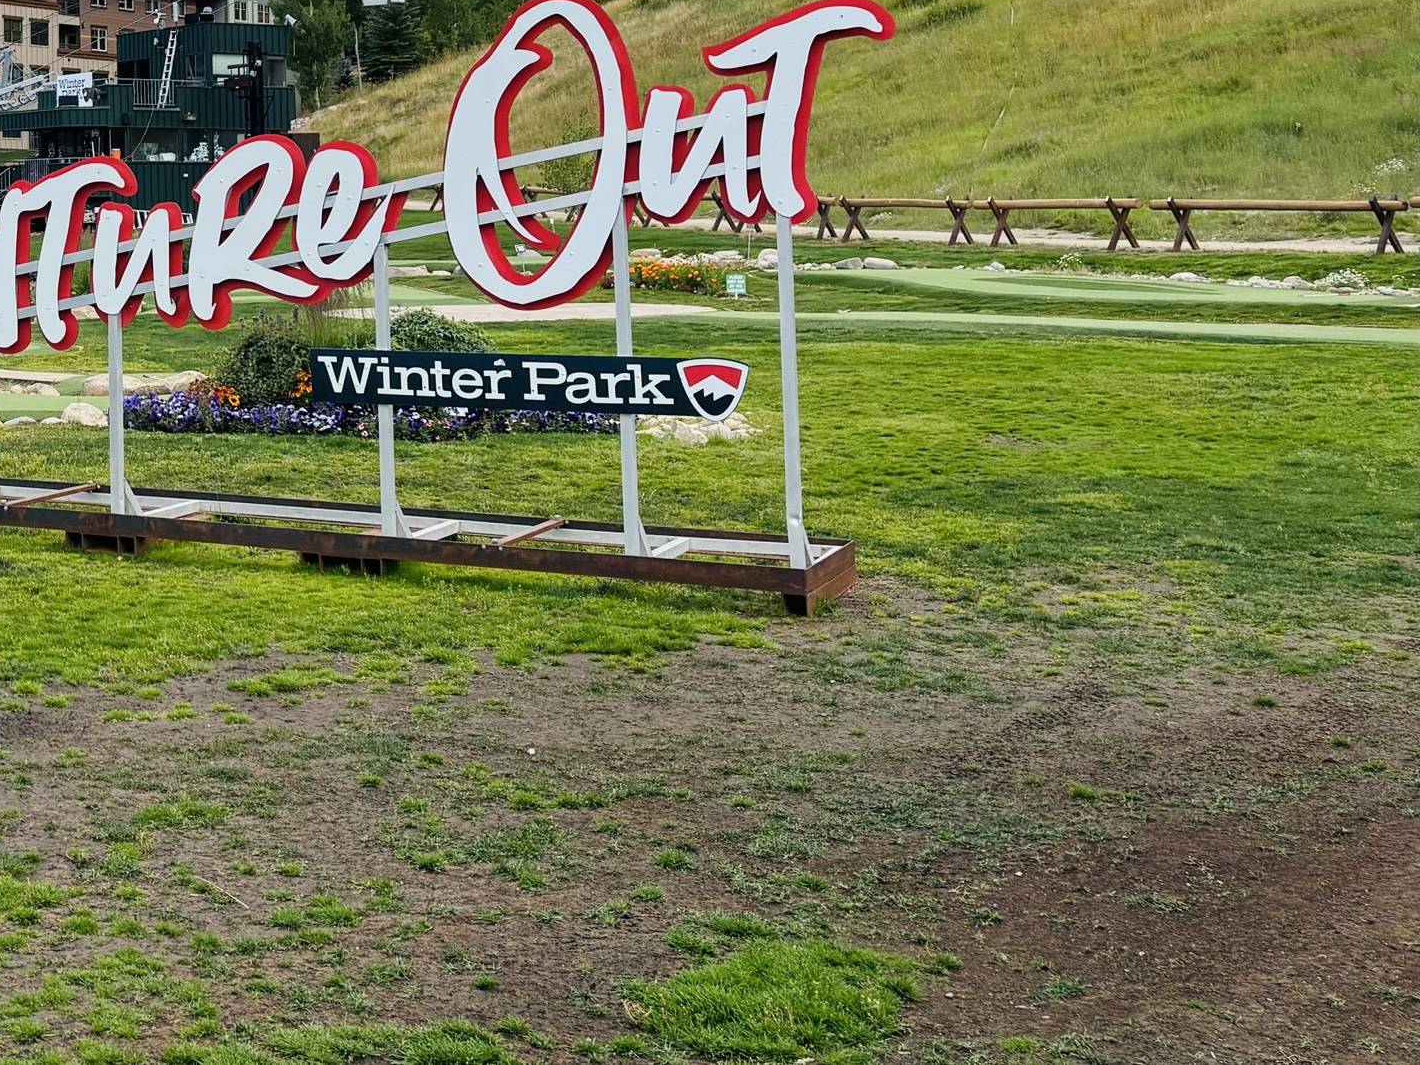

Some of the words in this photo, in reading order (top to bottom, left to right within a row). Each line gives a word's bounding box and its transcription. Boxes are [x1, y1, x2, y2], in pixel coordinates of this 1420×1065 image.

[58, 78, 85, 89] Winter
[317, 355, 511, 400] Winter
[522, 361, 674, 406] Park
